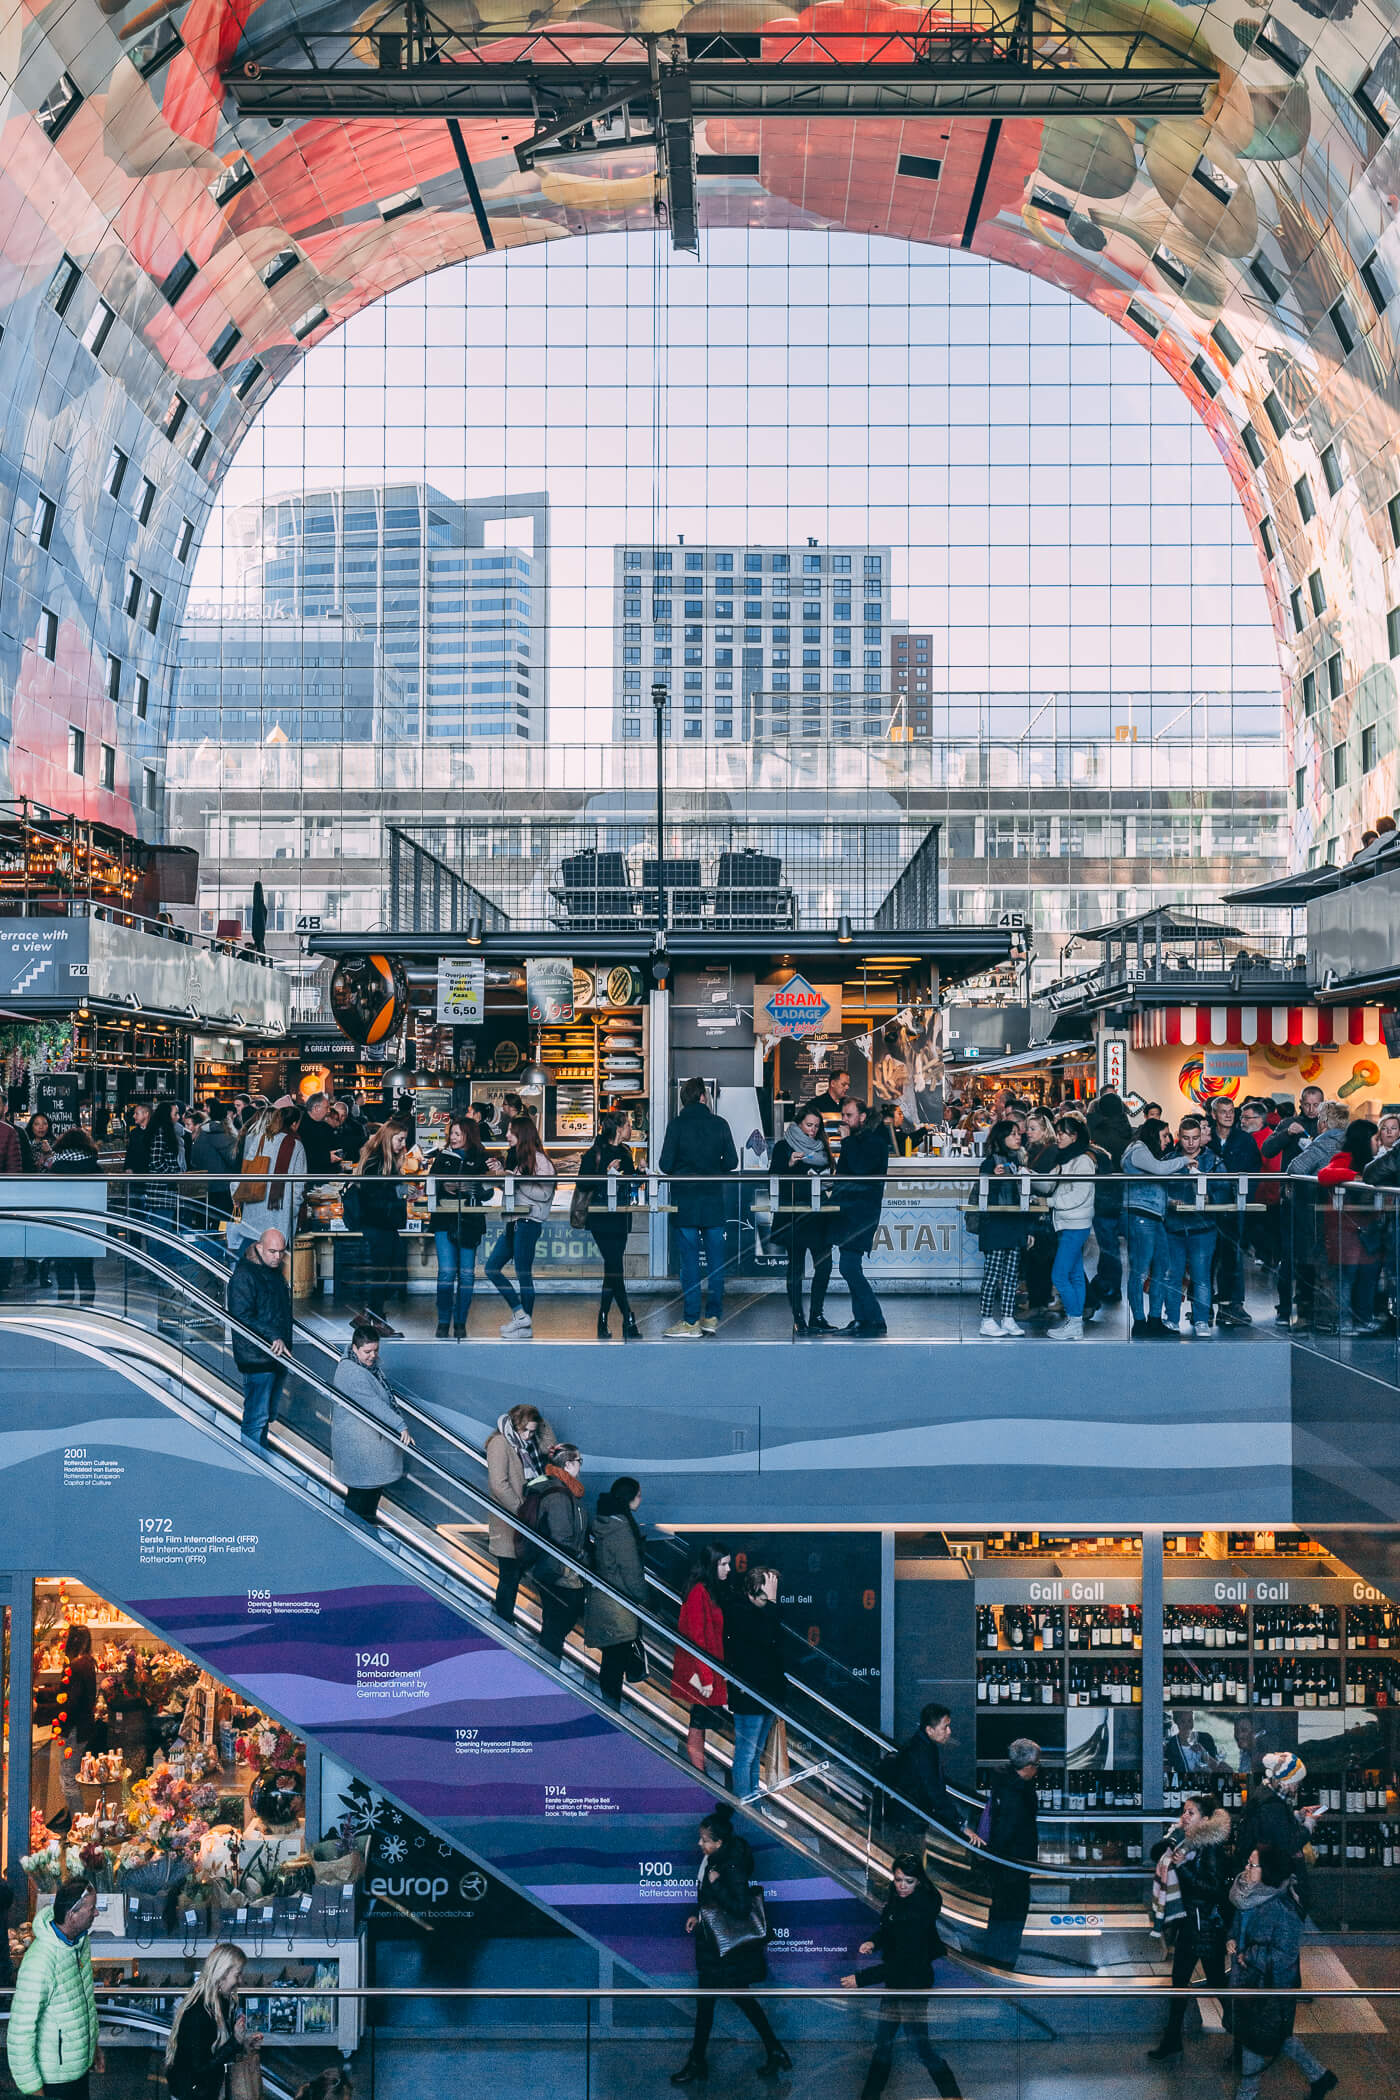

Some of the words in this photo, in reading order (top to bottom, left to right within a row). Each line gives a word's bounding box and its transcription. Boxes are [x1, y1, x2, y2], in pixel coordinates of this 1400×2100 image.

[297, 916, 320, 929] 48
[1000, 914, 1022, 926] 46
[43, 930, 68, 940] with
[24, 942, 52, 951] view
[1128, 971, 1144, 980] 16
[774, 993, 822, 1006] BRAM
[453, 1006, 477, 1016] 6,50
[774, 1009, 820, 1018] LADAGE
[1112, 1046, 1120, 1094] CAND
[52, 1100, 64, 1110] THE
[872, 1224, 957, 1252] ATAT
[64, 1448, 87, 1458] 2001
[139, 1518, 173, 1532] 1972
[140, 1536, 164, 1544] Eerste
[237, 1536, 258, 1544] (IFFR)
[185, 1556, 206, 1564] (IFFR)
[248, 1590, 270, 1600] 1965
[1030, 1582, 1062, 1600] Gall
[1072, 1582, 1104, 1600] Gall
[1214, 1582, 1246, 1600] Gall
[1256, 1582, 1288, 1600] Gall
[780, 1595, 794, 1604] Gall
[798, 1595, 812, 1604] Gall
[356, 1652, 390, 1666] 1940
[852, 1668, 867, 1676] Gall
[416, 1680, 428, 1689] by
[456, 1730, 478, 1740] 1937
[544, 1786, 566, 1796] 1914
[638, 1862, 672, 1876] 1900
[664, 1880, 694, 1888] 300.000
[363, 1878, 448, 1902] leurop
[640, 1889, 682, 1897] Rotterdam
